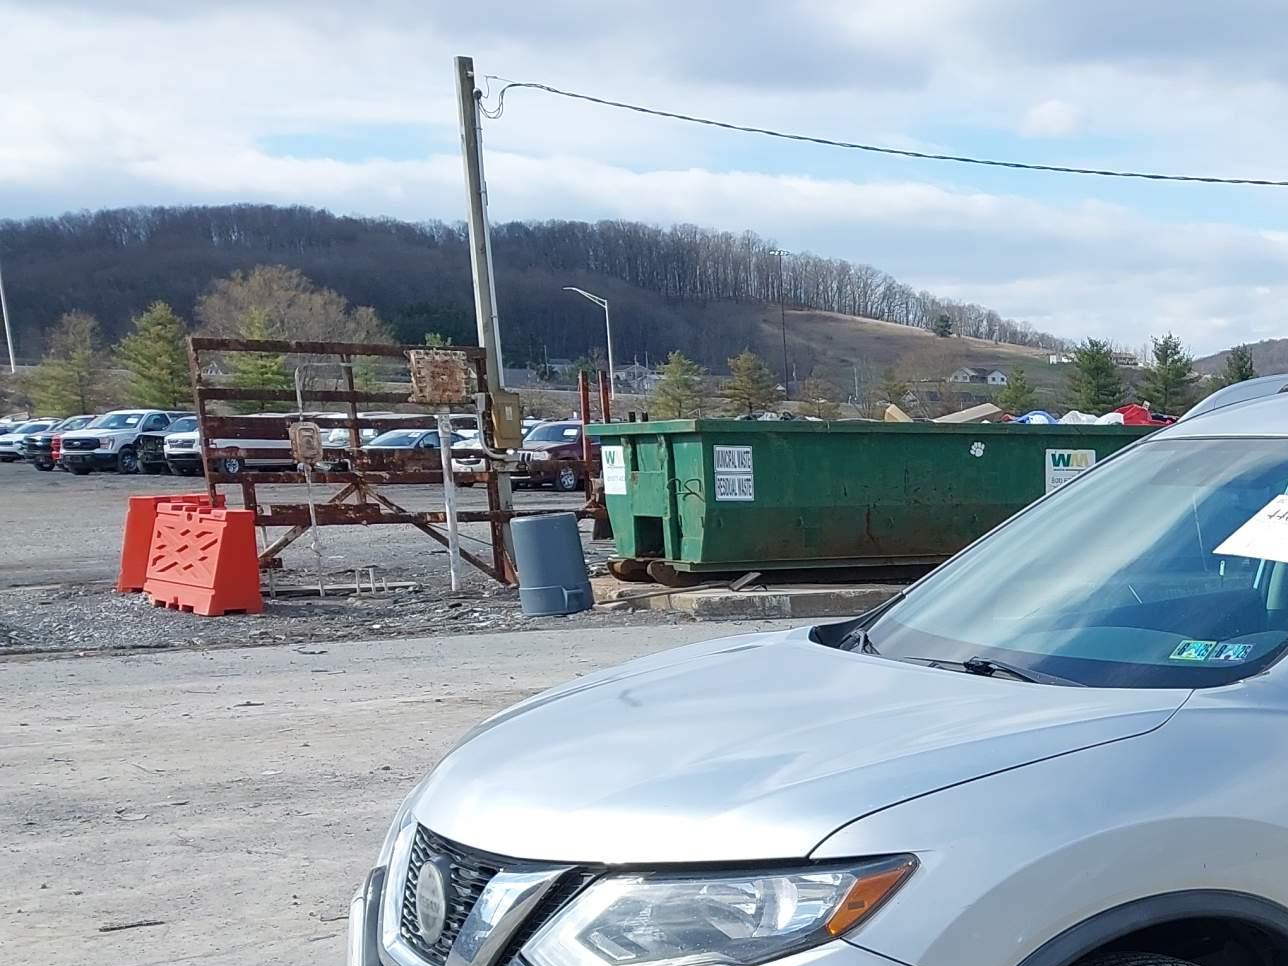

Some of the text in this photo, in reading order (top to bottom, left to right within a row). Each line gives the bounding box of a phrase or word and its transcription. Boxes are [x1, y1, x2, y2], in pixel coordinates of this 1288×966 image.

[737, 450, 751, 469] WASTE
[1050, 453, 1089, 467] WM
[737, 478, 752, 497] WASTE
